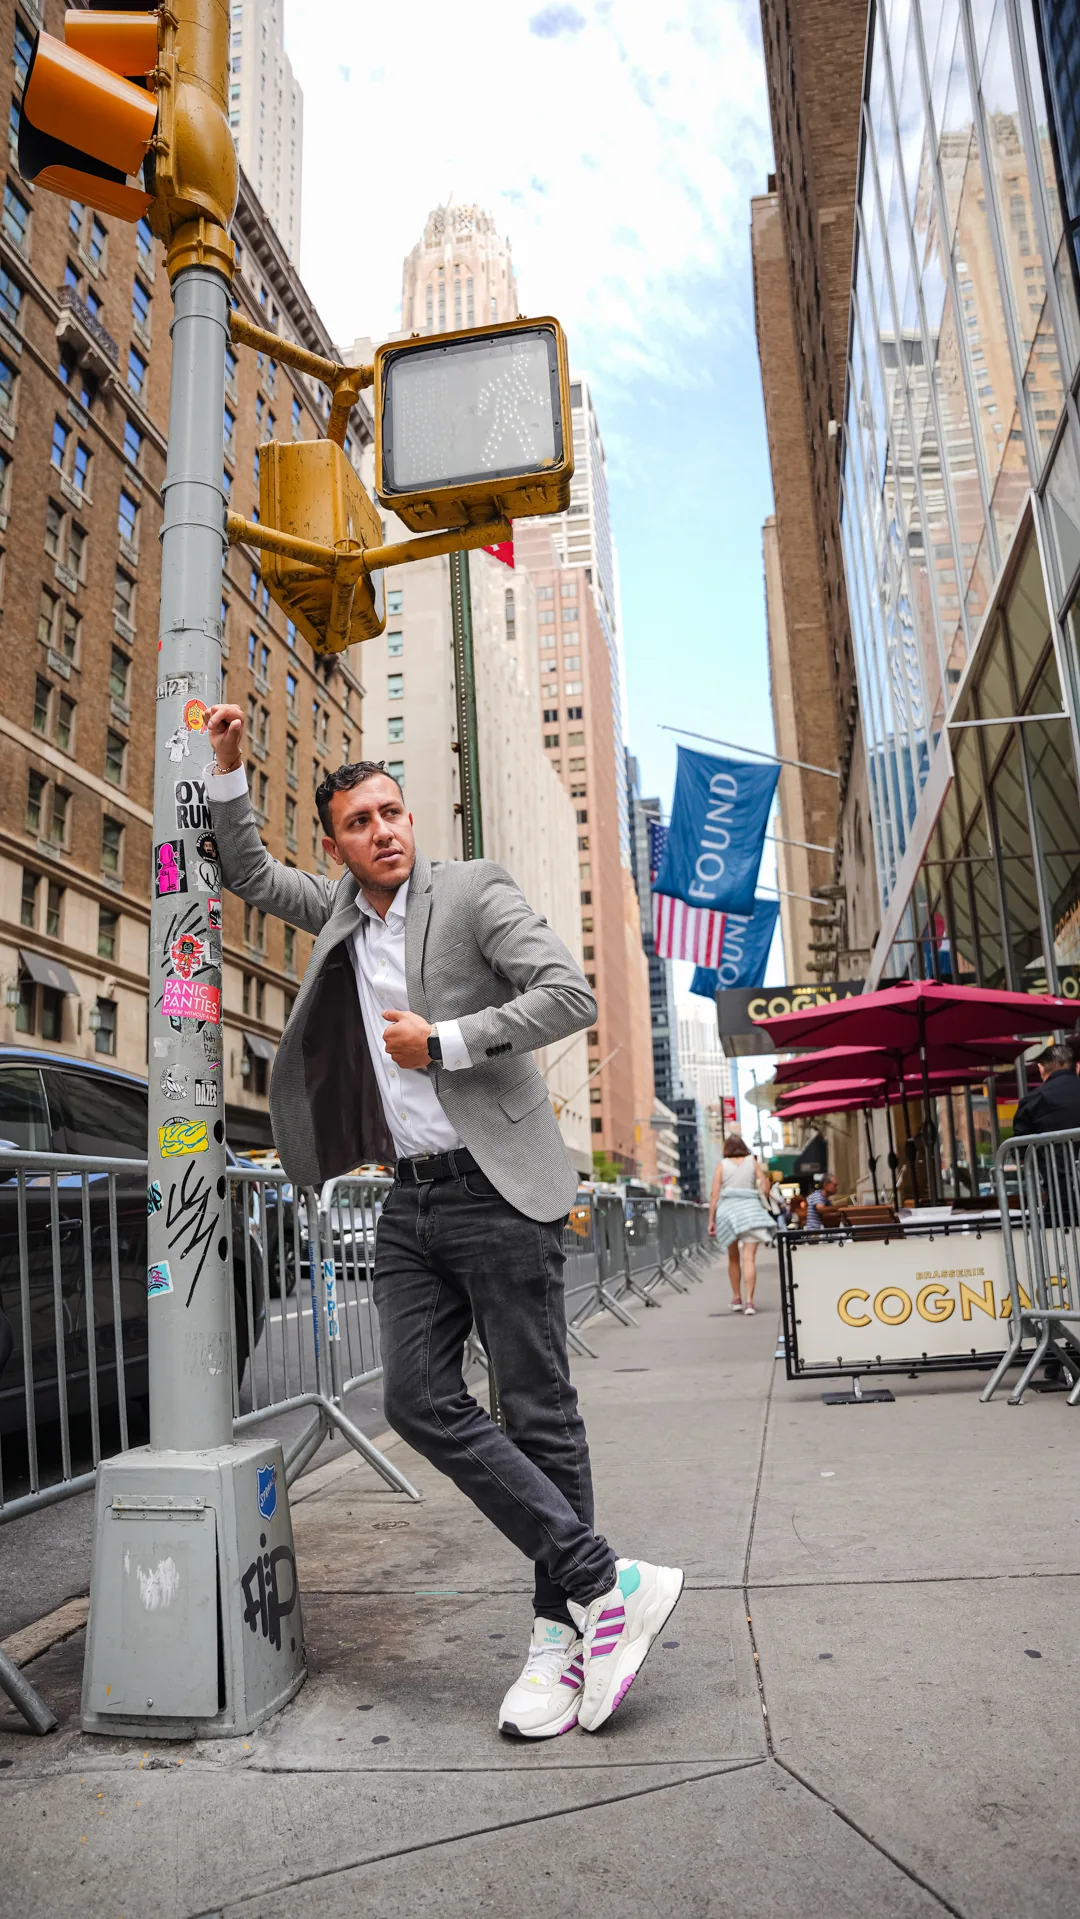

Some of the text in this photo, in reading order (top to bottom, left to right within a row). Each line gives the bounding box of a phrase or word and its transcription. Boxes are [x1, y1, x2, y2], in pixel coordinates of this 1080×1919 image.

[688, 772, 738, 900] FOUND
[715, 912, 754, 991] OUN
[165, 981, 208, 999] PANIC
[162, 995, 218, 1015] PANTIES
[184, 1010, 205, 1018] WITHOUT
[748, 991, 853, 1021] COGN
[195, 1083, 217, 1107] DAZES
[915, 1267, 985, 1280] BRASSERIE
[323, 1261, 339, 1337] NYPD
